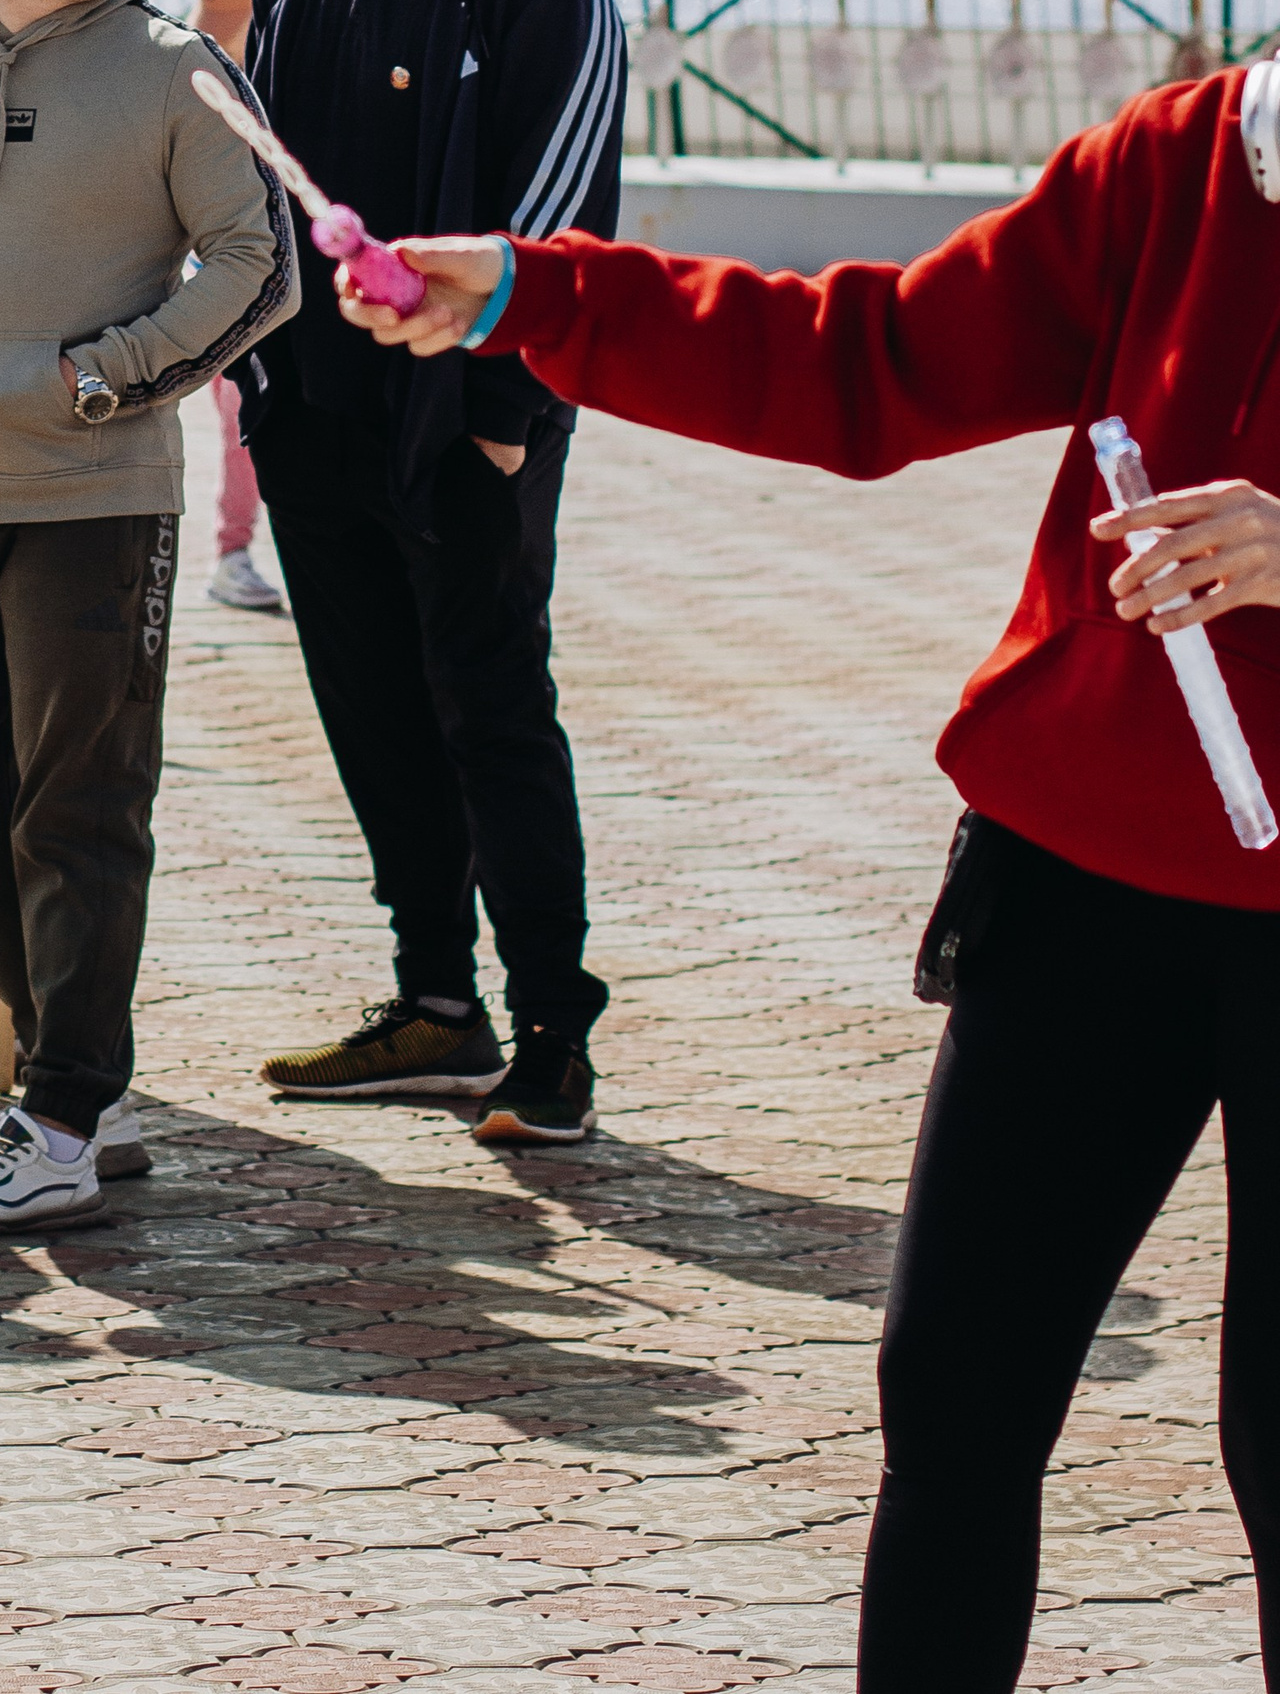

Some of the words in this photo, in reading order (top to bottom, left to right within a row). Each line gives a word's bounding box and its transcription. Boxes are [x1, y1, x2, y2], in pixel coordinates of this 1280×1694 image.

[210, 323, 245, 358] adidas
[217, 331, 252, 366] adidas
[155, 363, 193, 390] adidas
